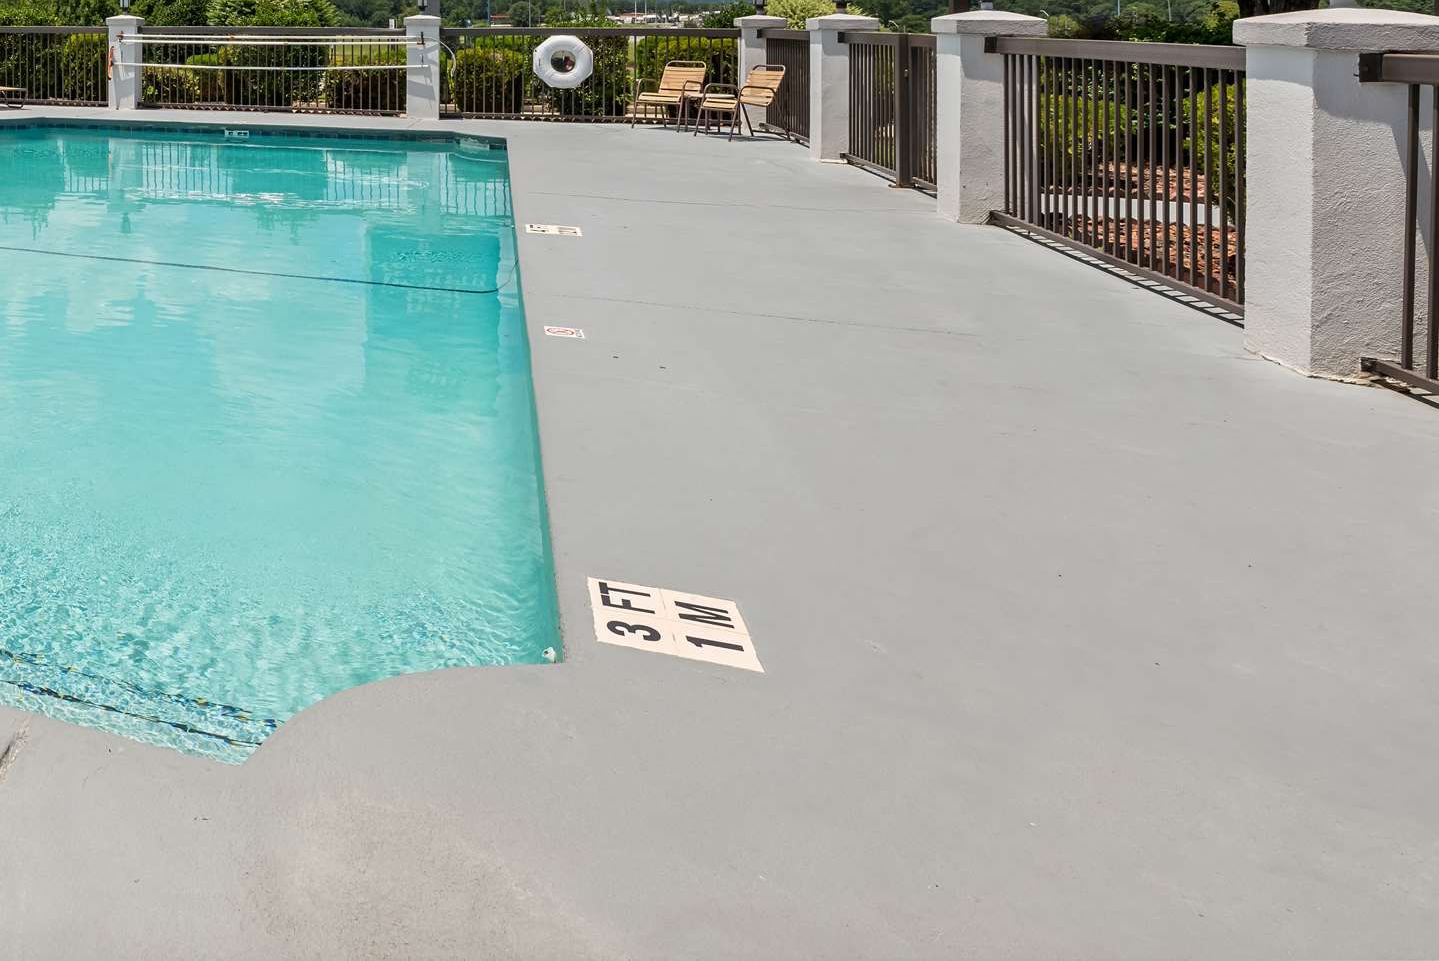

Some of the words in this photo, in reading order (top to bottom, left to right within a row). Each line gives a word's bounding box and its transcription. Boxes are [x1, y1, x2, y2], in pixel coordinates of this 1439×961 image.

[598, 581, 656, 614] FT
[674, 600, 735, 629] M
[606, 620, 661, 642] 3
[685, 635, 744, 652] 1
